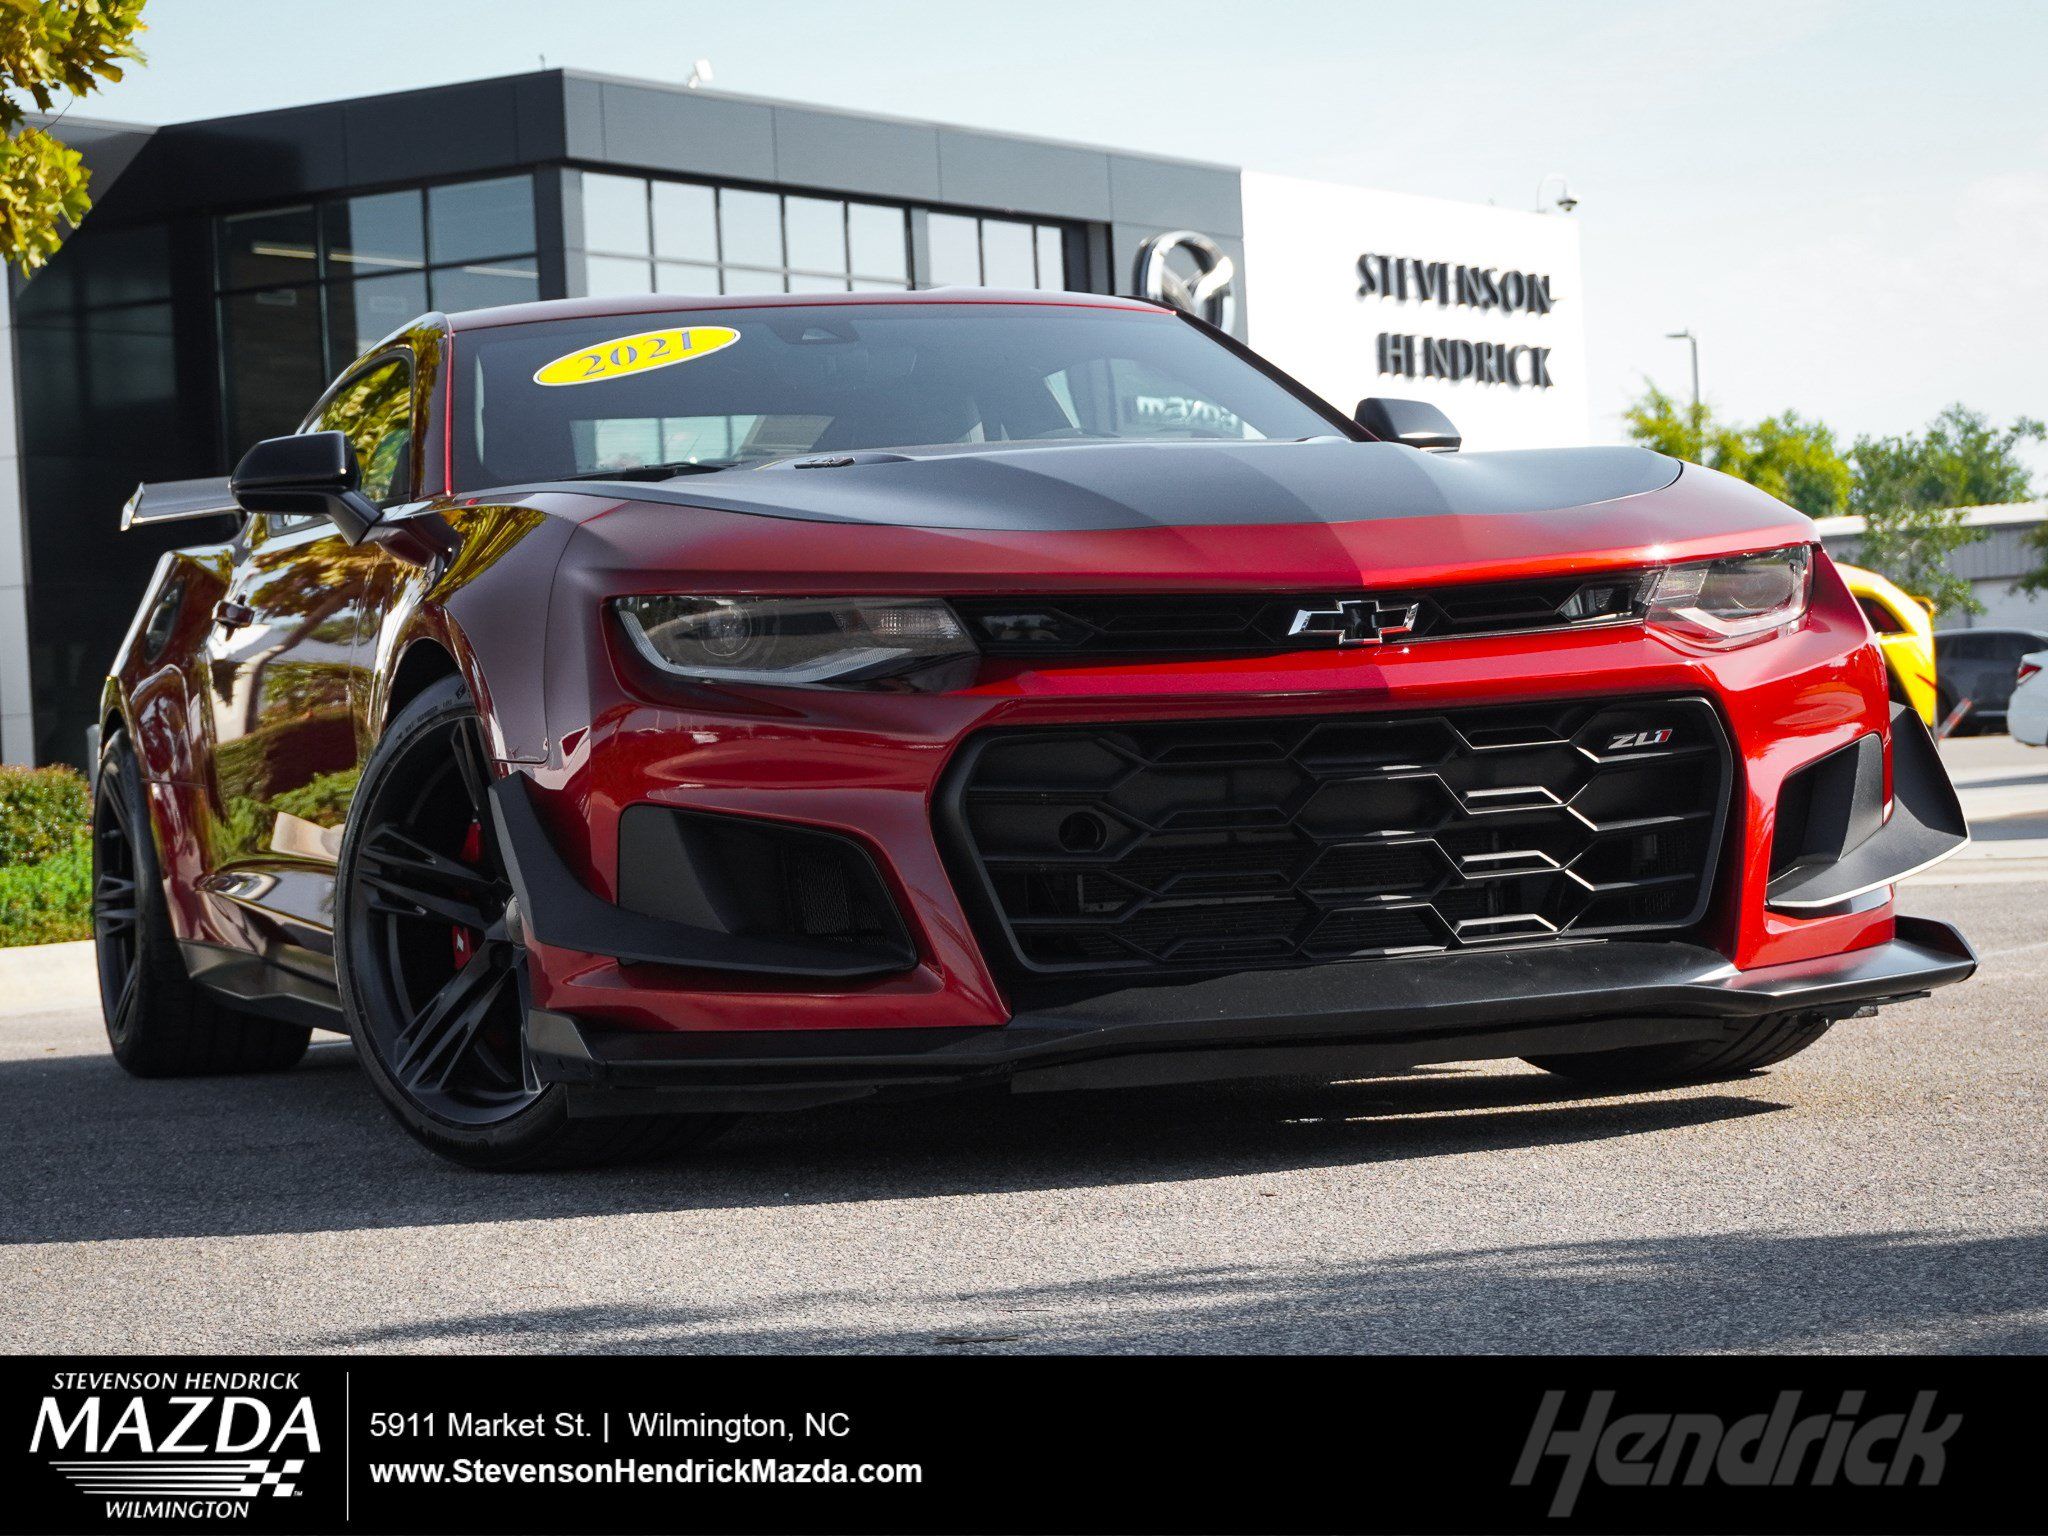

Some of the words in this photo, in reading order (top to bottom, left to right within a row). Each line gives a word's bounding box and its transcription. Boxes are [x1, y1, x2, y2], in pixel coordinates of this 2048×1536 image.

[1356, 254, 1556, 317] STEVENSON
[578, 330, 692, 376] 2021
[1376, 332, 1554, 390] HENDRICK
[1608, 728, 1673, 750] ZL1
